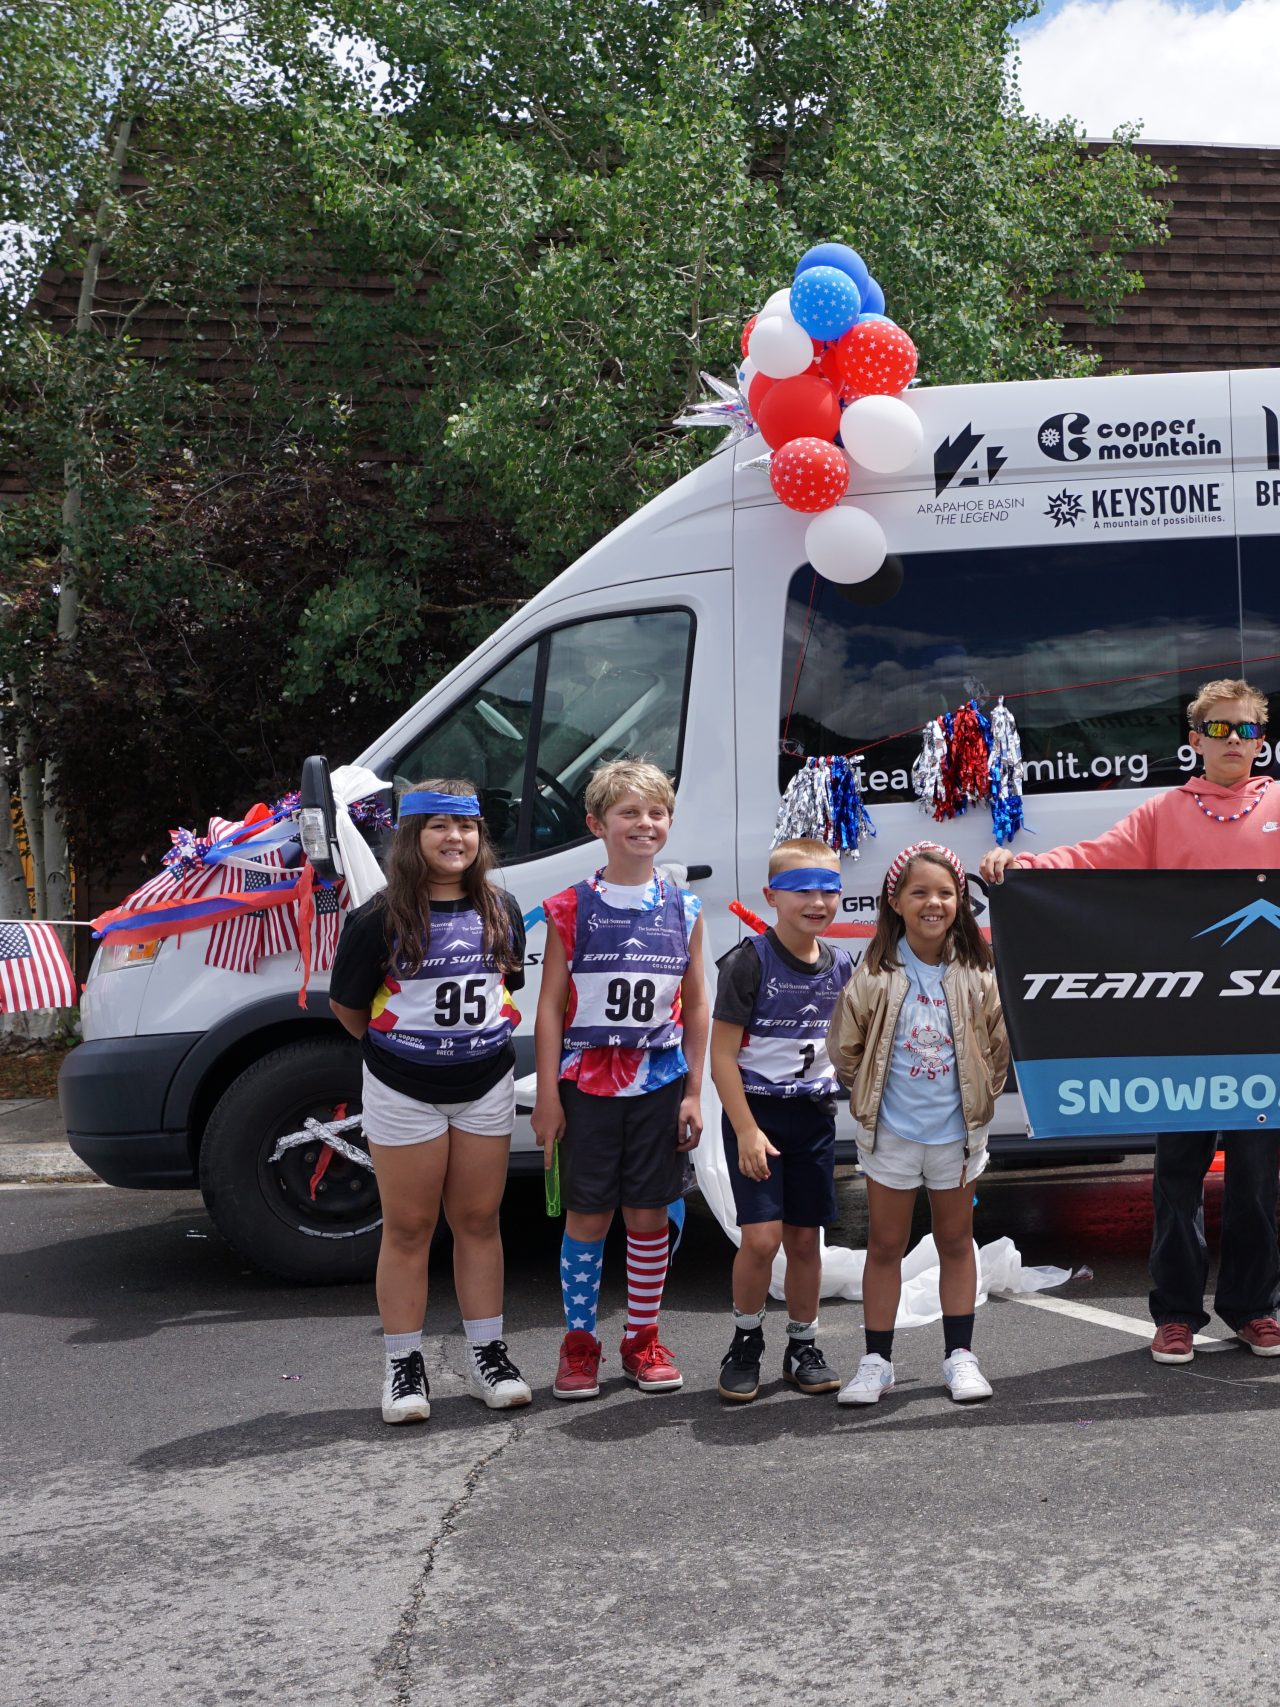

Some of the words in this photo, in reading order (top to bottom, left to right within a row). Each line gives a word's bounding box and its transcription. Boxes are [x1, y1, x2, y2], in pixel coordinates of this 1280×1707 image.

[1097, 419, 1196, 442] copper
[1099, 433, 1221, 460] mountain
[917, 500, 984, 514] ARAPAHOE
[988, 498, 1025, 510] BASIN
[1092, 483, 1221, 519] KEYSTONE
[935, 514, 957, 525] THE
[960, 511, 1009, 524] LEGEND
[1093, 521, 1101, 529] A
[1103, 519, 1148, 529] mountain
[1151, 517, 1161, 526] of
[1163, 514, 1225, 527] possibilities.
[583, 953, 620, 962] EAM
[622, 953, 684, 964] SUMMIT
[1022, 970, 1205, 1000] TEAM
[434, 979, 487, 1027] 95
[605, 978, 656, 1023] 98
[755, 1018, 798, 1027] TEAM
